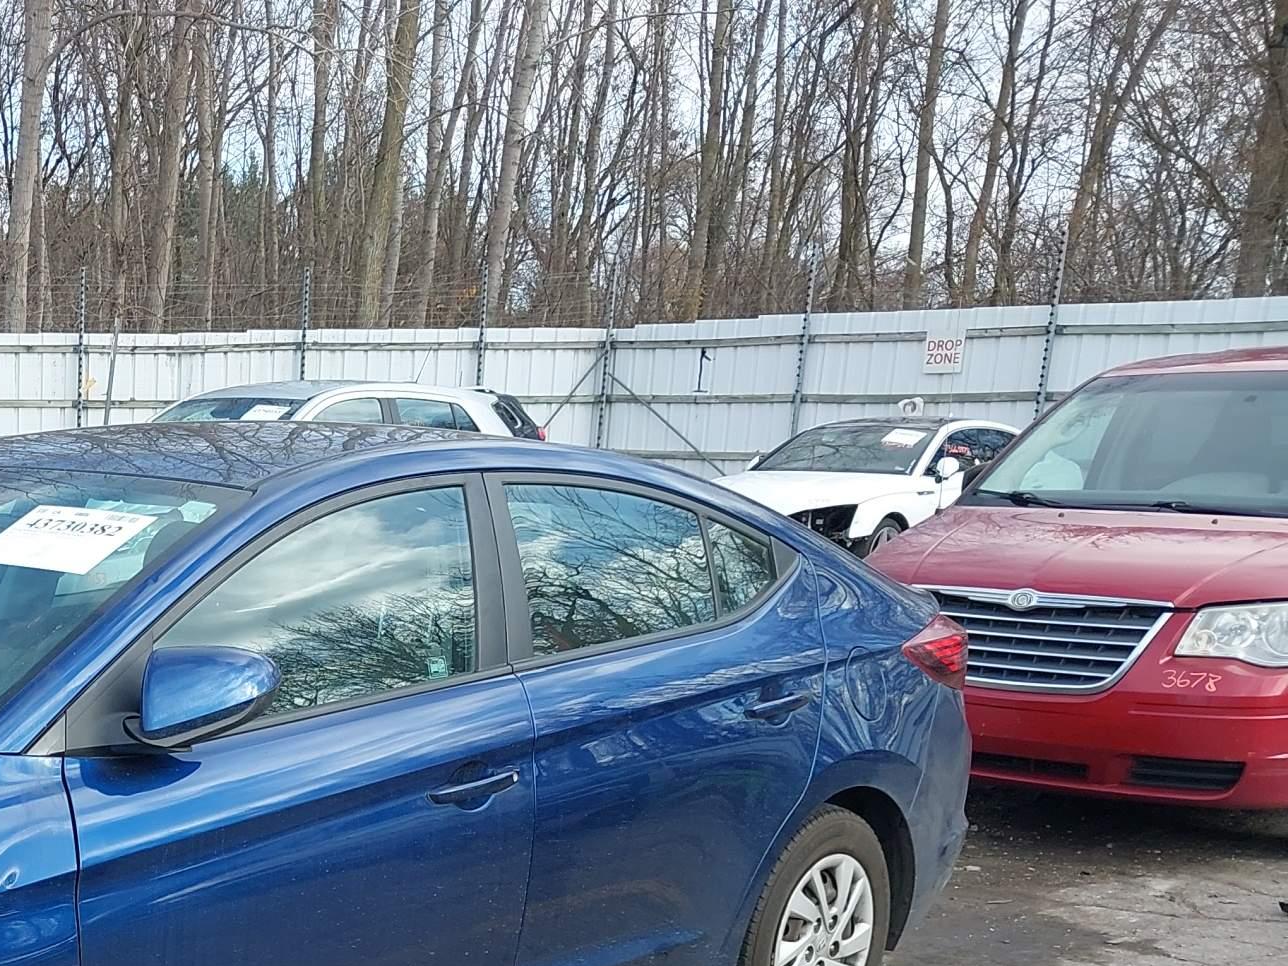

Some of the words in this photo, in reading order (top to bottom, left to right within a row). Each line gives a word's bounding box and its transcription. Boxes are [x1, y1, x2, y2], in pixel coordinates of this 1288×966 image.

[927, 339, 963, 352] DROP
[926, 352, 961, 365] ZONE
[26, 518, 124, 537] 43730382
[1161, 669, 1222, 692] 3678
